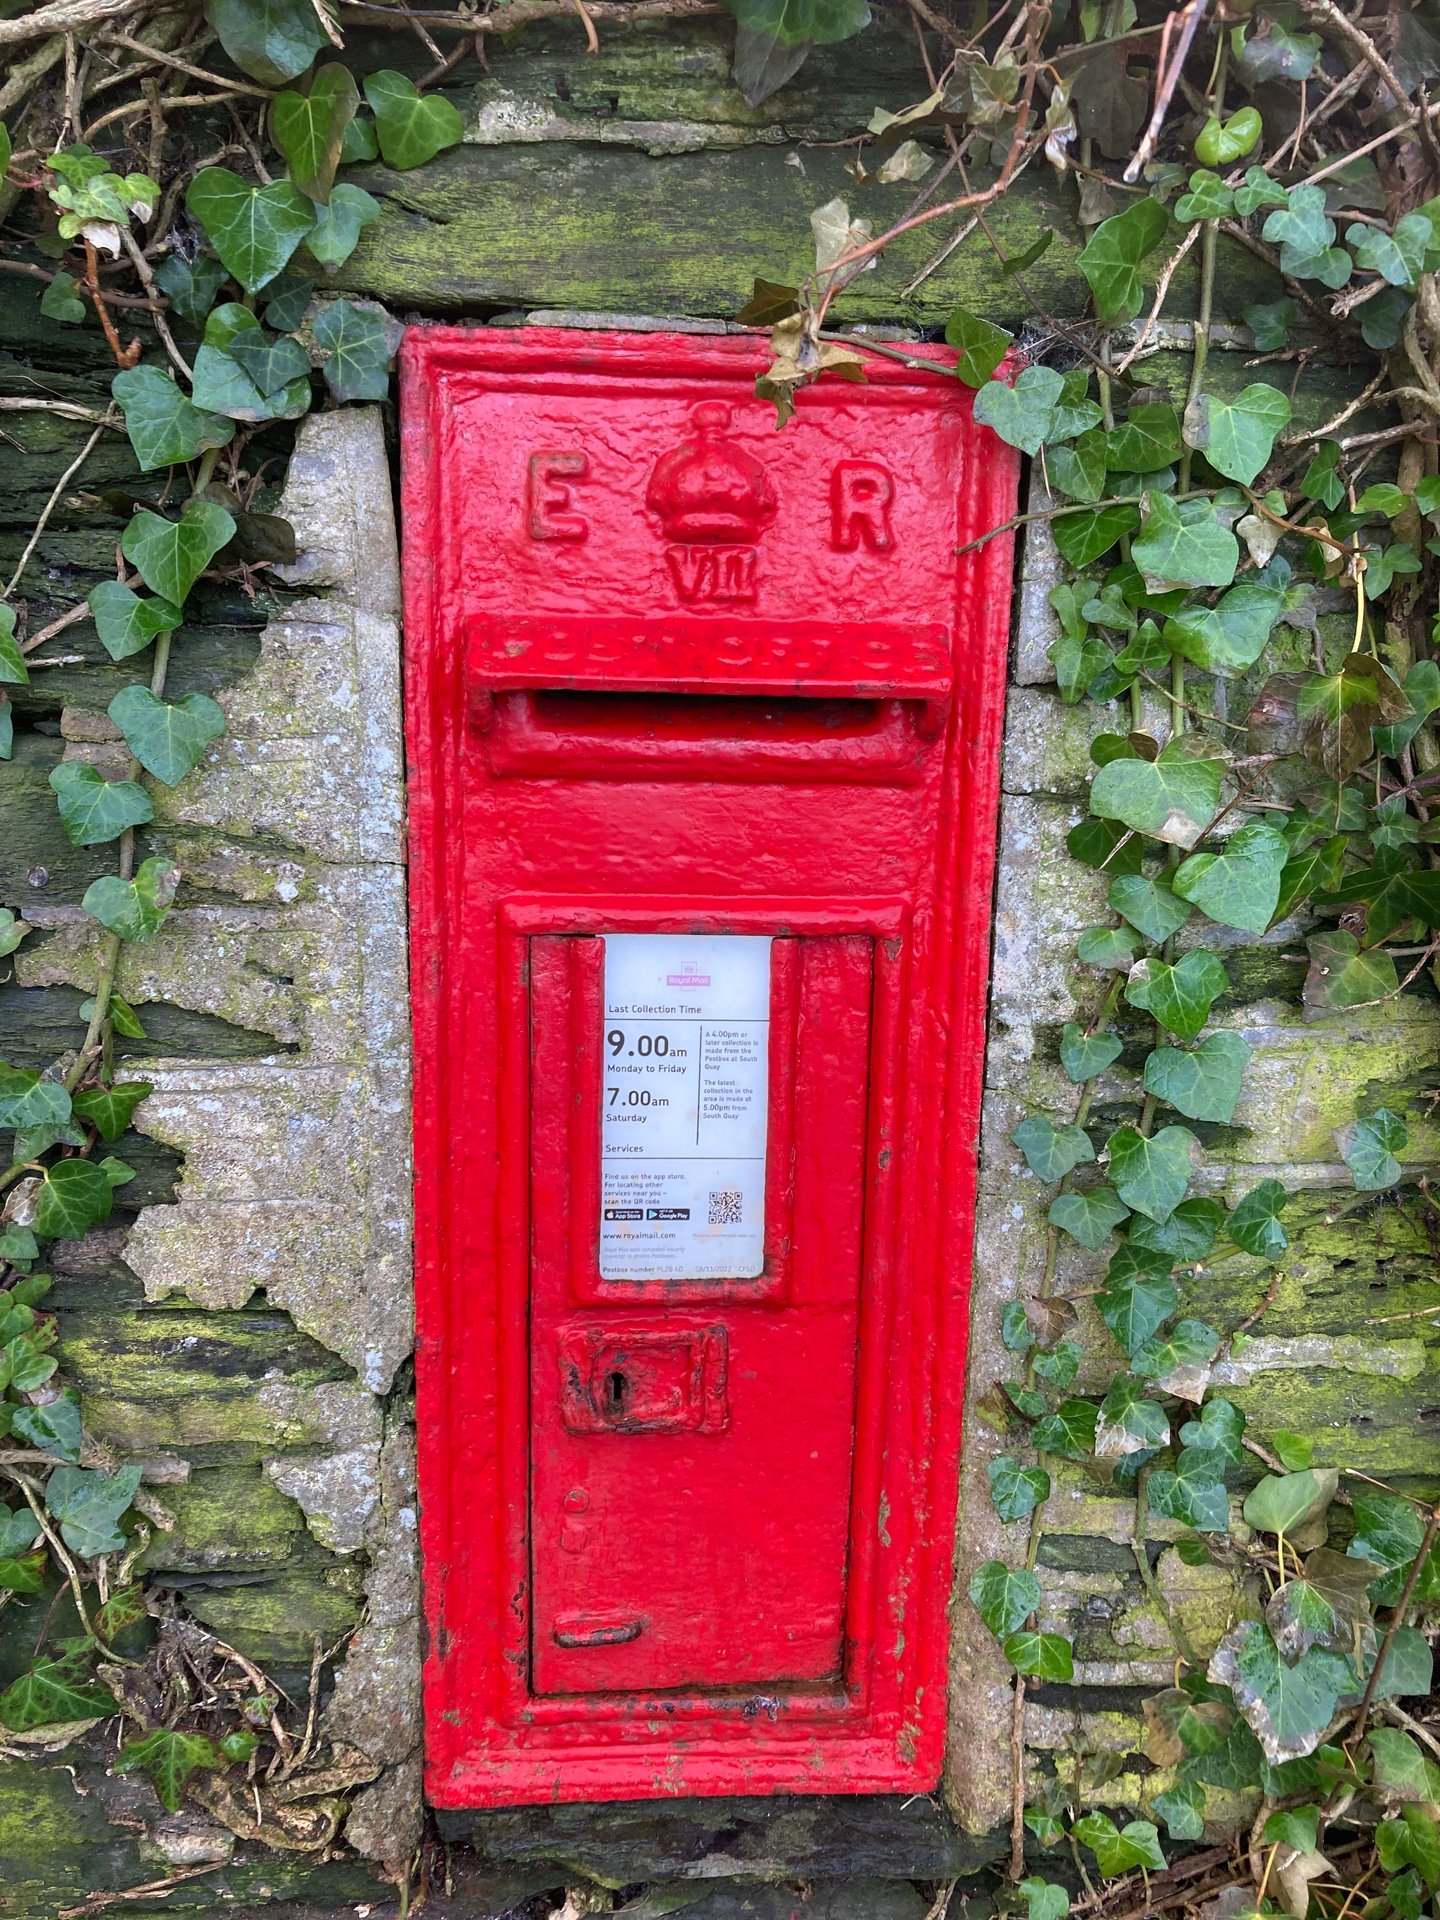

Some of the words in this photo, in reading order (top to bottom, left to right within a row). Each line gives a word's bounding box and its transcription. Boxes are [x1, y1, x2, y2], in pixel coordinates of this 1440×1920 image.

[527, 450, 588, 542] E
[831, 459, 894, 552] R
[609, 1004, 629, 1013] Last
[631, 1004, 676, 1014] Collection
[679, 1005, 702, 1014] Time
[711, 1031, 739, 1039] 4.00pm
[607, 1064, 643, 1074] Monday
[646, 1065, 655, 1073] to
[658, 1064, 687, 1075] Friday
[607, 1087, 669, 1107] 7.00am
[703, 1104, 730, 1112] 5.00pm
[606, 1114, 647, 1123] Saturday
[723, 1112, 739, 1120] Quay
[605, 1144, 644, 1153] Services
[603, 1232, 676, 1240] www.royalmail.com
